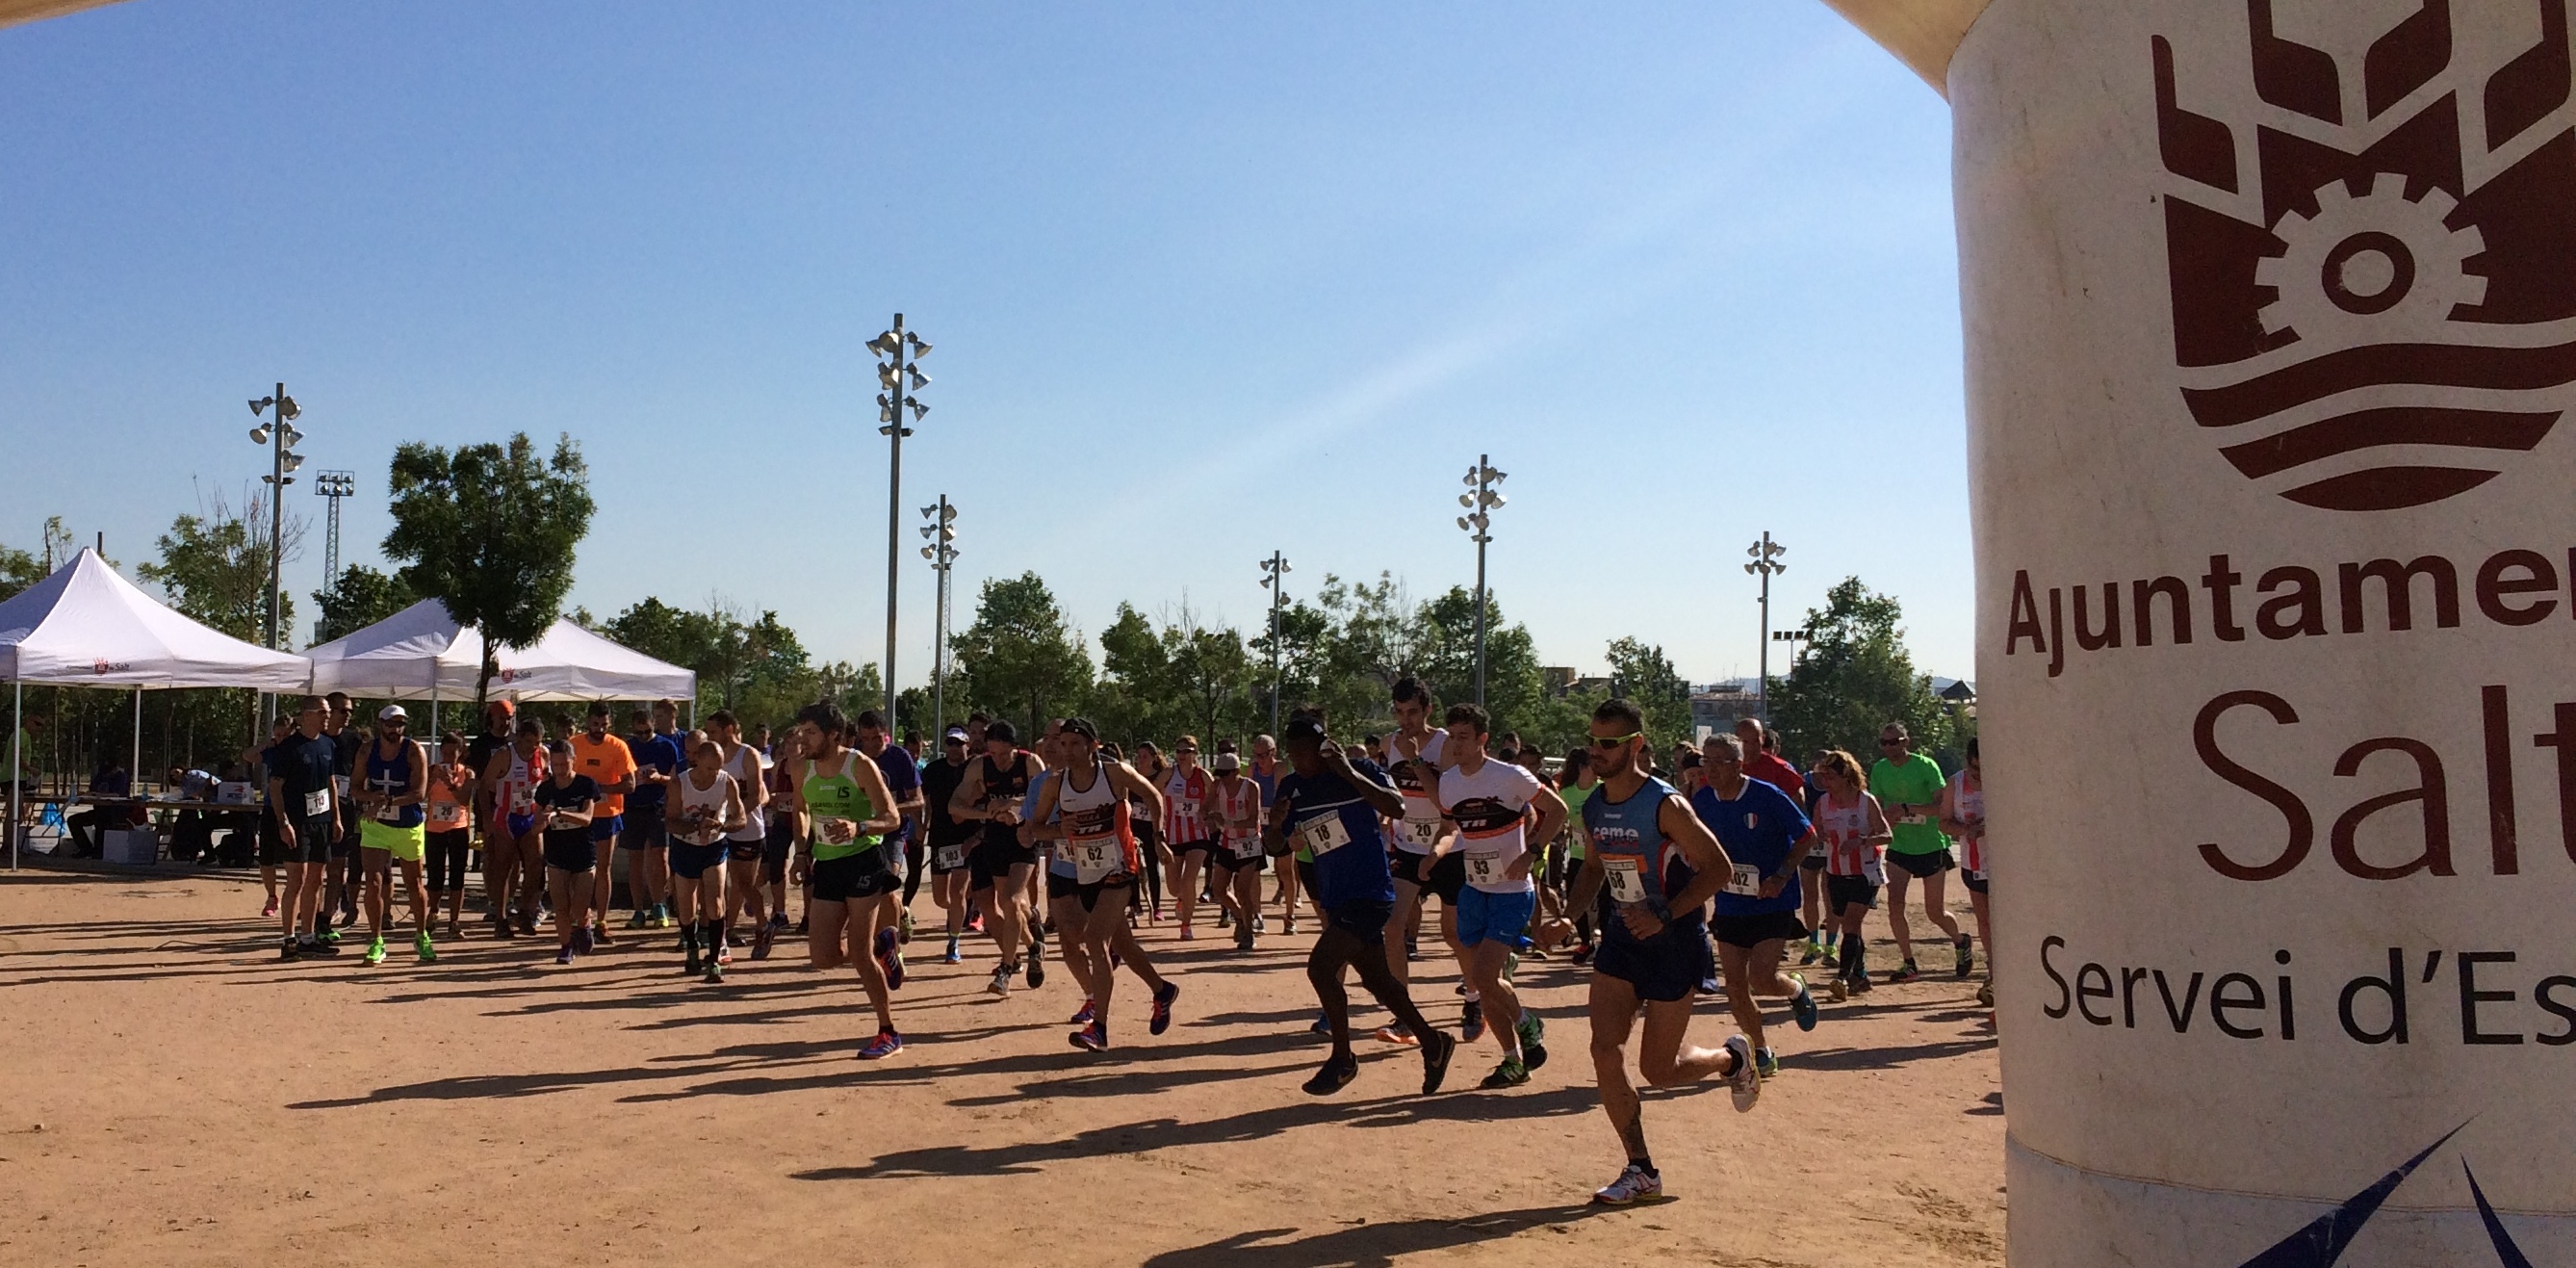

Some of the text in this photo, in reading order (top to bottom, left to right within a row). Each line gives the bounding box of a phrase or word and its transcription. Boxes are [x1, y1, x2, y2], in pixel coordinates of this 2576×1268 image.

[2006, 548, 2576, 678] Ajuntame
[2194, 685, 2576, 882] Salt
[1315, 824, 1330, 841] 18
[1416, 824, 1431, 837] 20
[1087, 847, 1104, 861] 62
[1473, 860, 1490, 875] 93
[1608, 870, 1626, 890] 68
[1732, 872, 1749, 887] 02
[2041, 936, 2296, 1041] Servei
